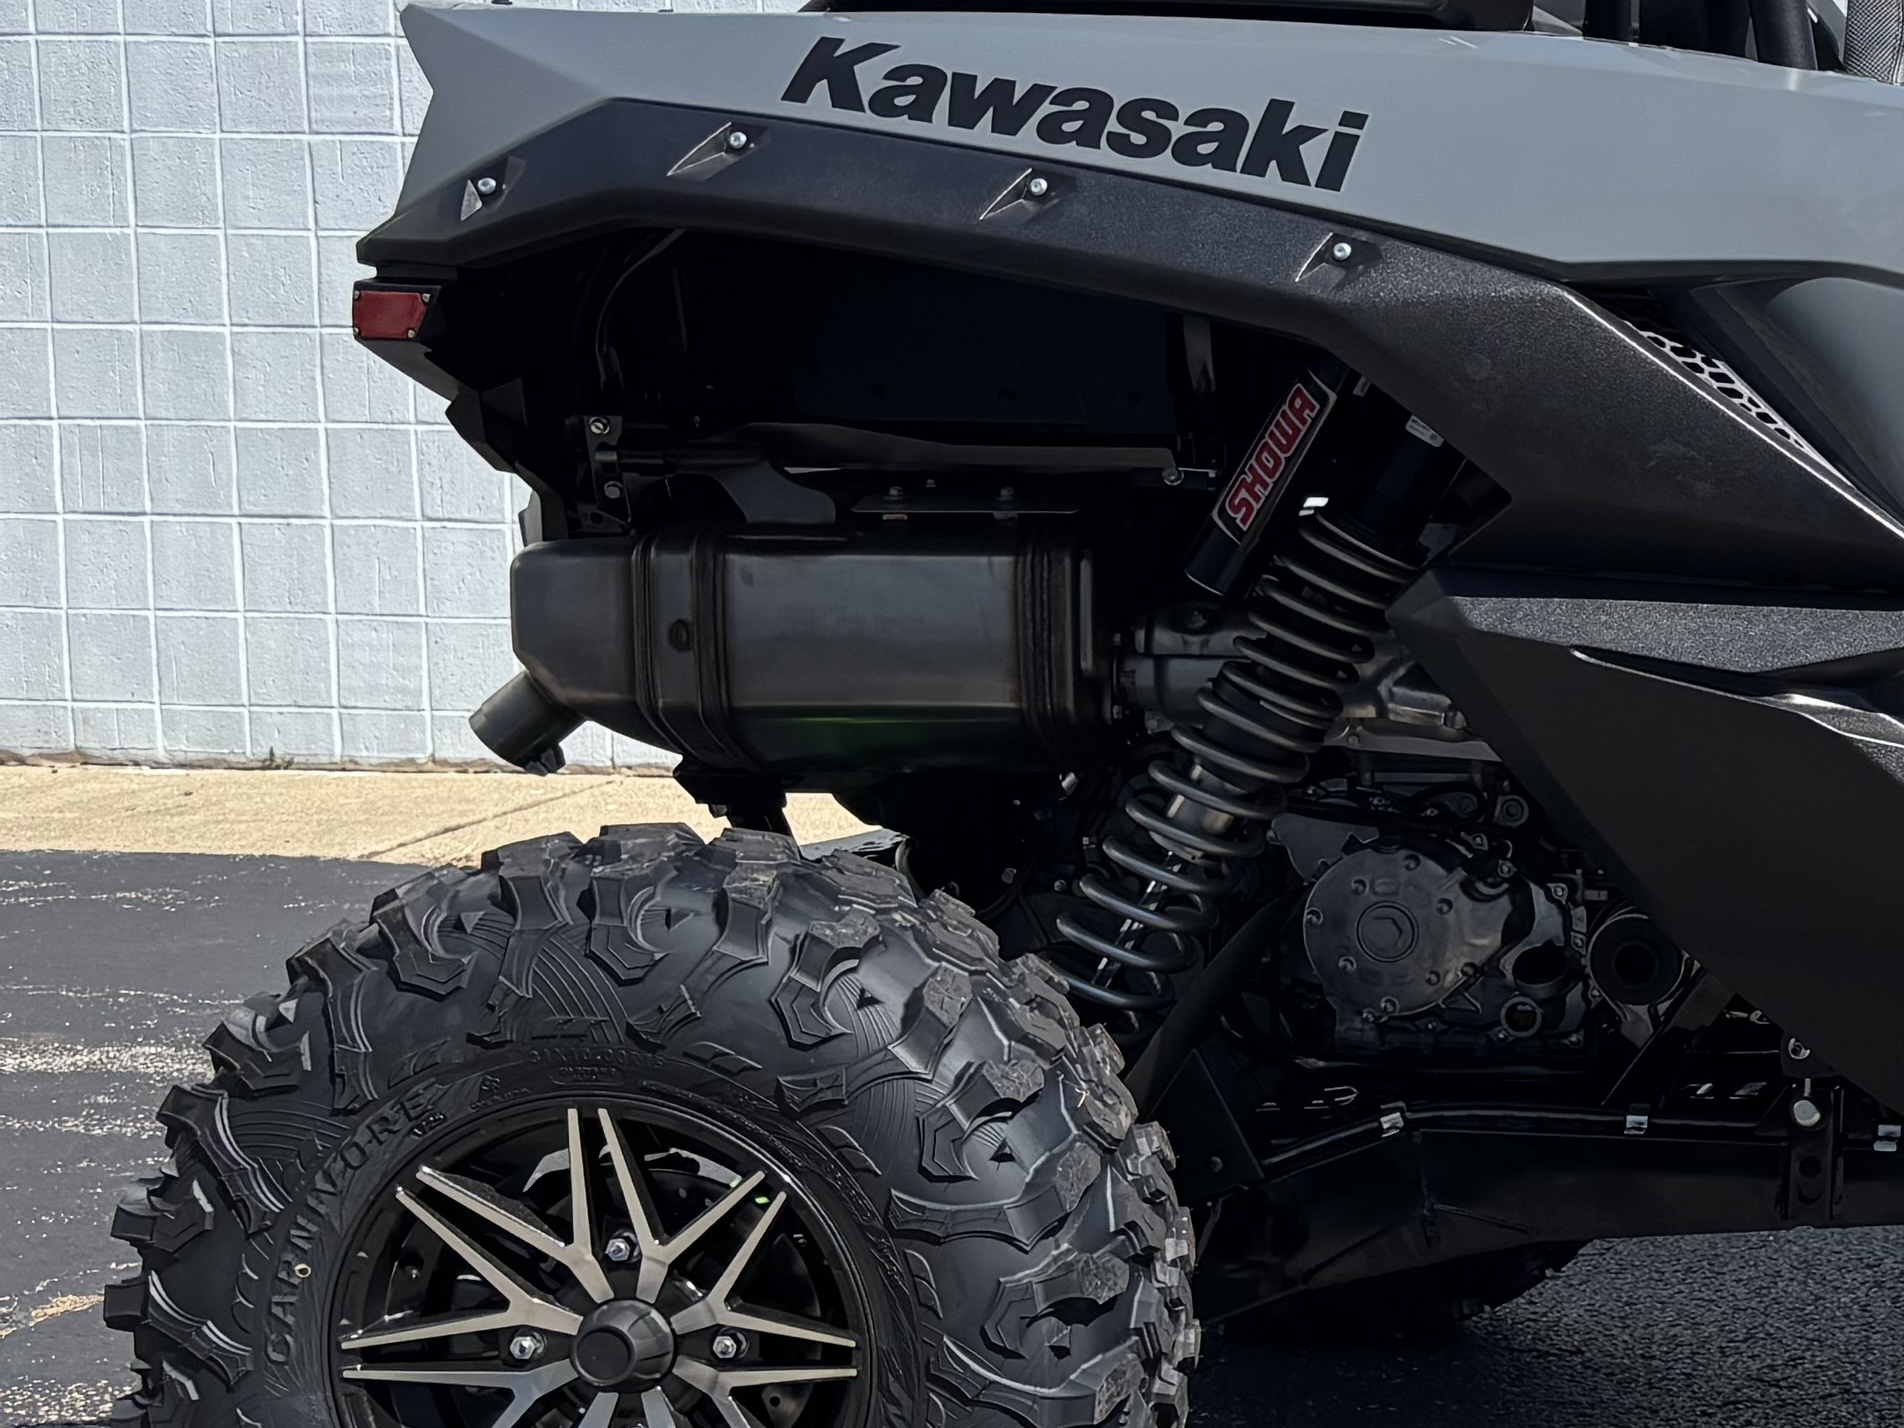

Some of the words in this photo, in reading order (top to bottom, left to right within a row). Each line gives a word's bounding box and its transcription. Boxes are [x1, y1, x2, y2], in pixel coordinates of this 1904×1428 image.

[780, 36, 1370, 193] Kawasaki
[1225, 383, 1320, 531] SHOWA
[262, 1083, 435, 1365] CARNIVORE
